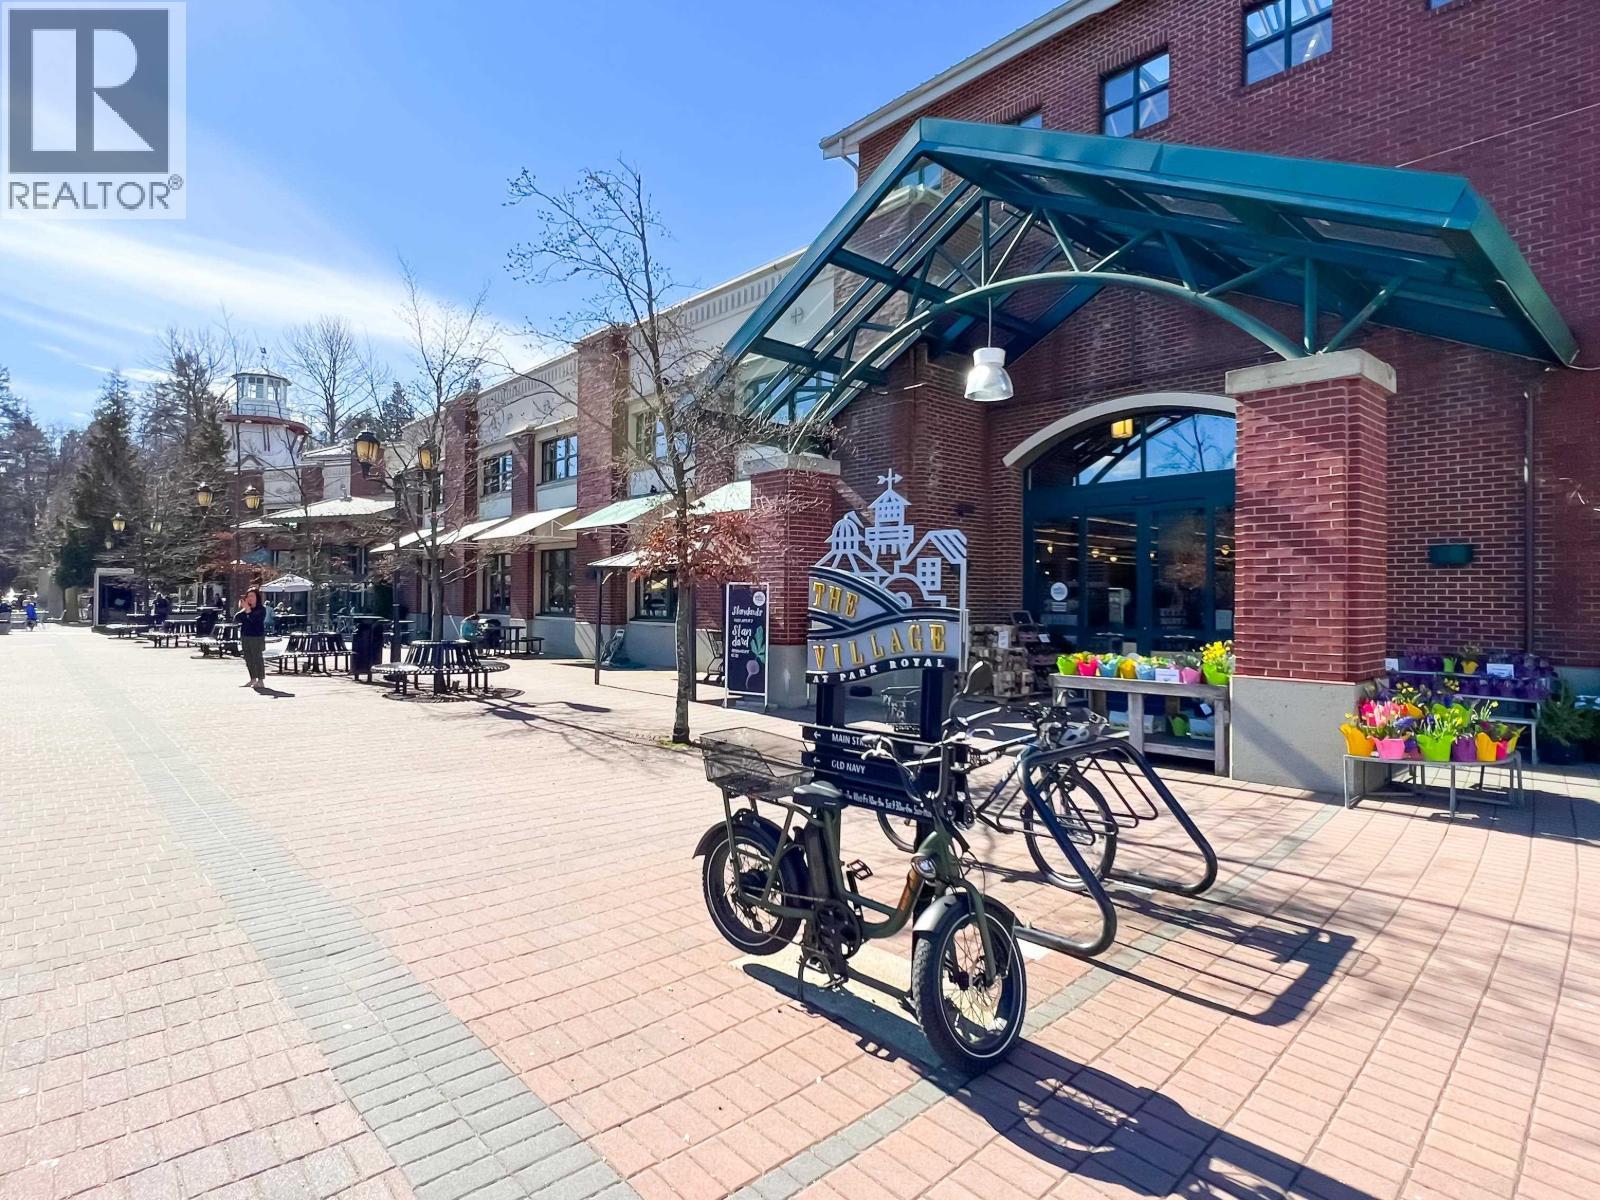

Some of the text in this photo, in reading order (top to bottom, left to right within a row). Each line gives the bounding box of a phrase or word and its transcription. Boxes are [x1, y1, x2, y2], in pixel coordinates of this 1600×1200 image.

[812, 581, 860, 619] THE
[812, 624, 946, 671] VILLAGE
[812, 658, 945, 684] AT PARK ROYAL
[831, 733, 851, 745] MAIN
[846, 762, 866, 774] NAVY
